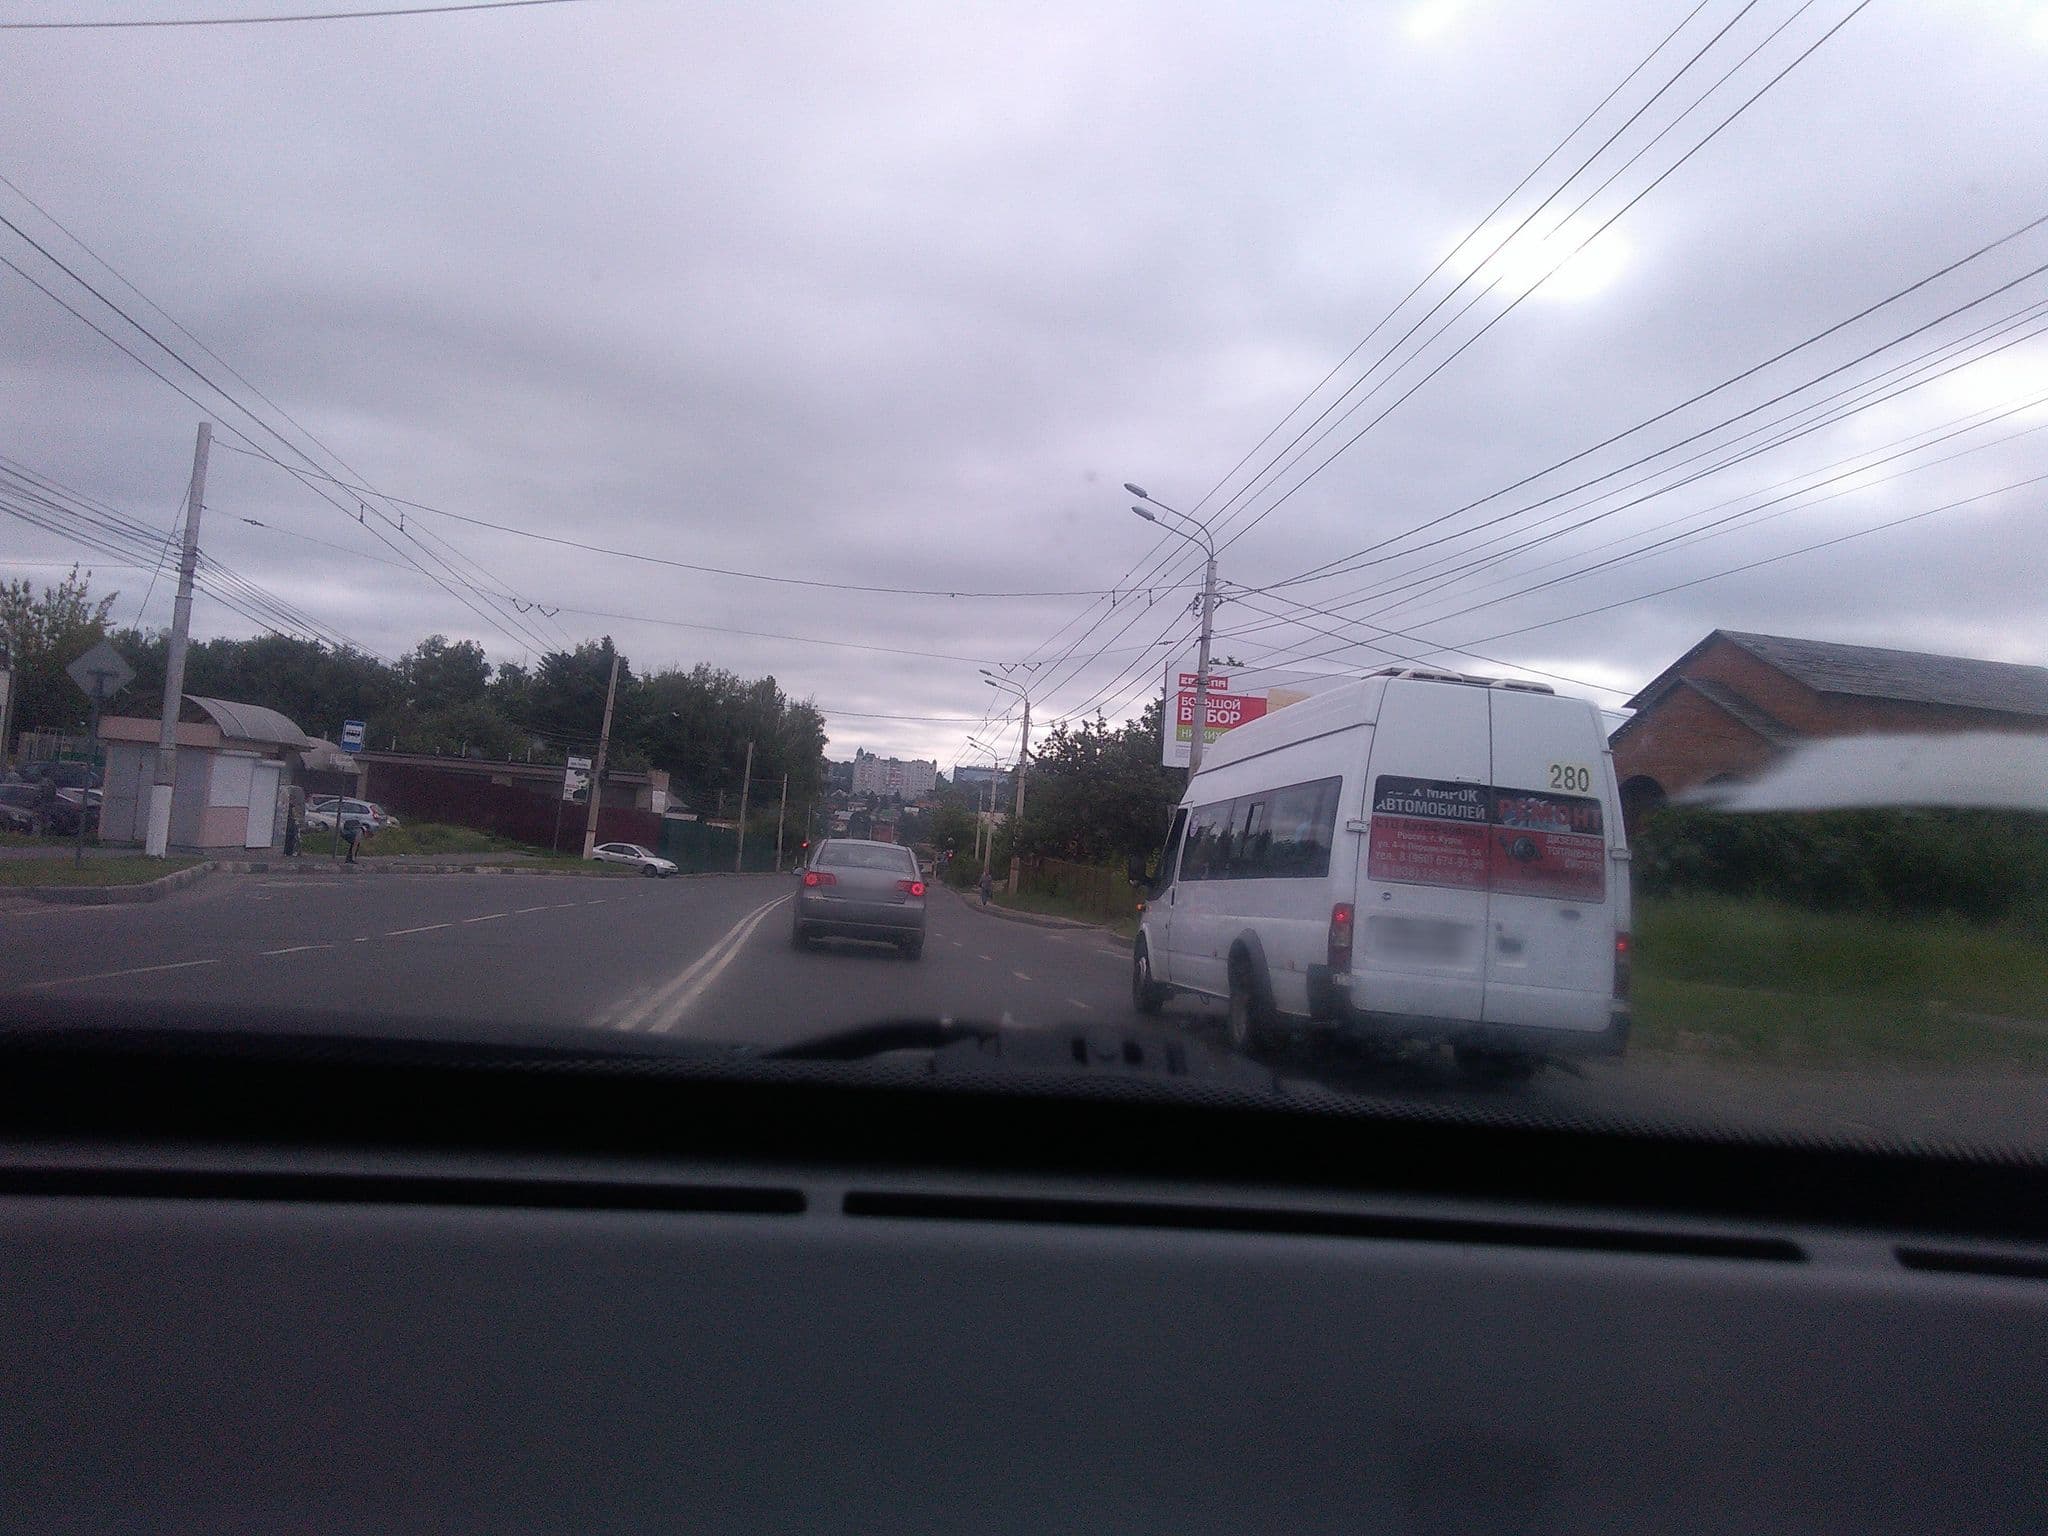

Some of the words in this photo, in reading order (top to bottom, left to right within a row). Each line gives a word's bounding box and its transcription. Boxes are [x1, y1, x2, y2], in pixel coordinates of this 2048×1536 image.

[1181, 696, 1241, 711] БОЬШОЙ
[1181, 706, 1241, 724] ВБОР
[1550, 764, 1590, 793] 280
[1375, 797, 1486, 820] АВТОМОБИЛЕЙ
